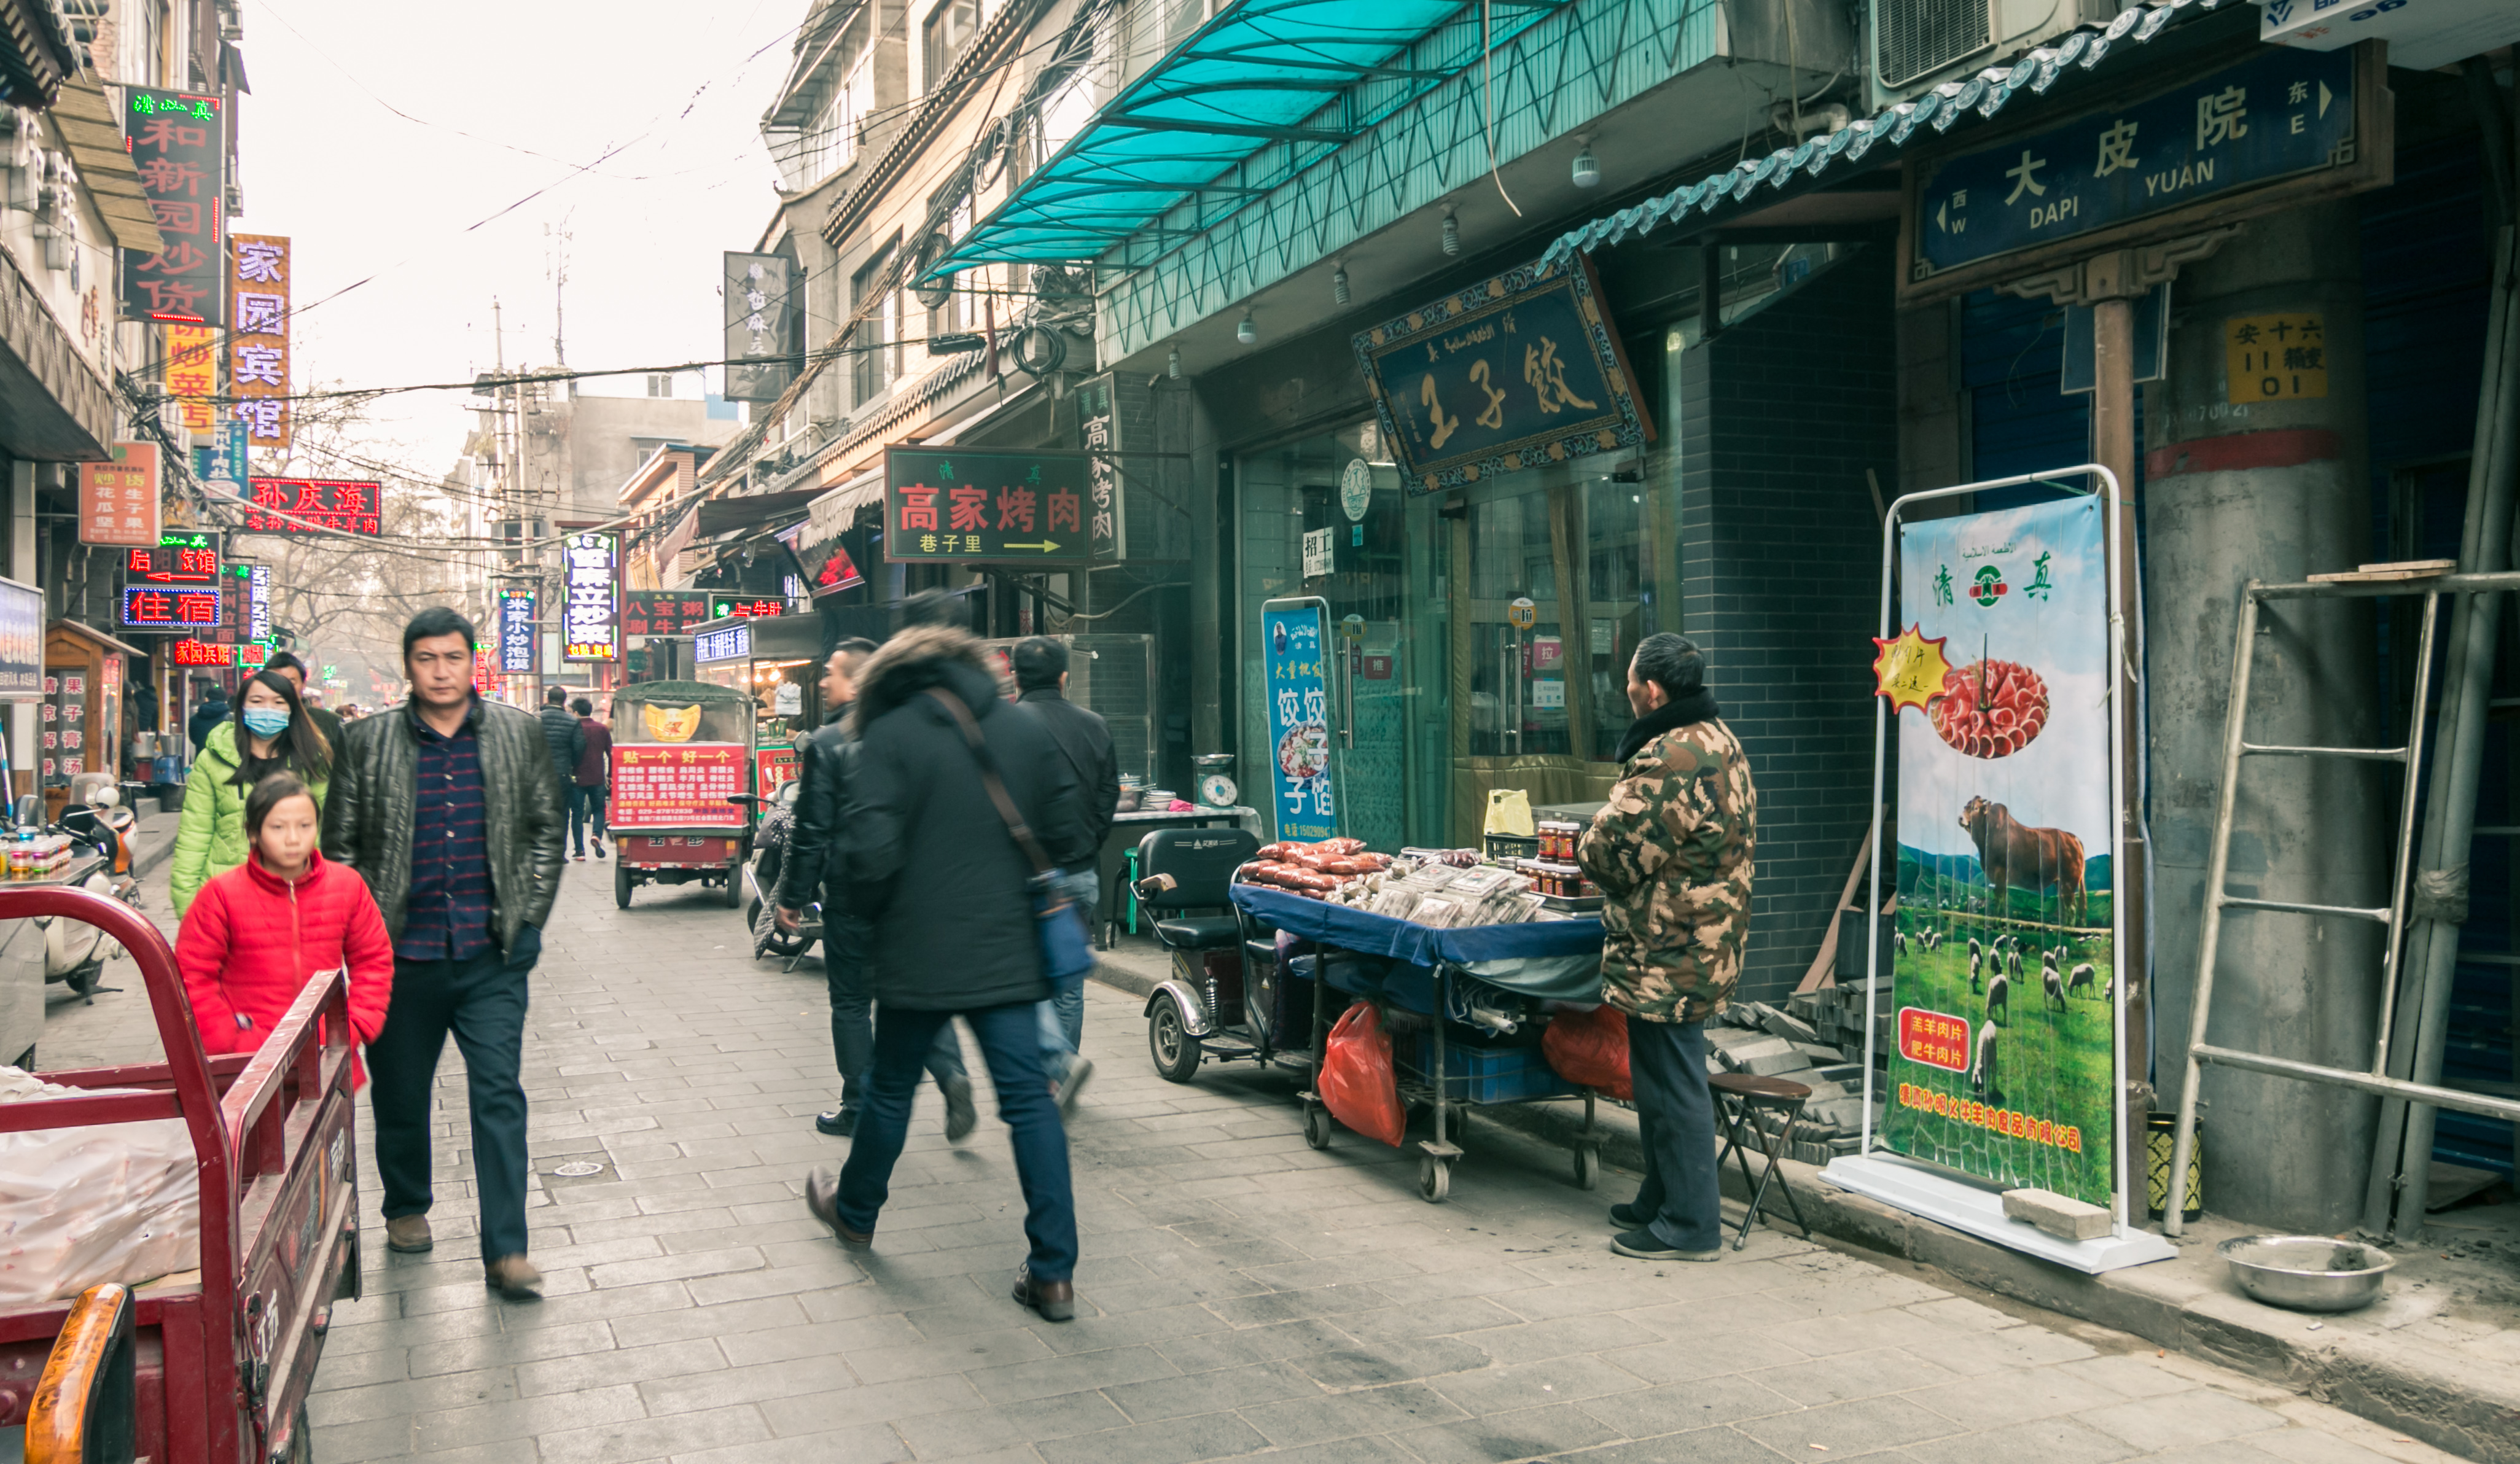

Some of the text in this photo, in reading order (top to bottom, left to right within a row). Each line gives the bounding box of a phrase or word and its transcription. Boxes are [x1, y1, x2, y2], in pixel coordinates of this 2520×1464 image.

[2288, 81, 2308, 104] 东
[2291, 114, 2304, 134] E
[2004, 85, 2248, 206] 大皮院
[2145, 158, 2214, 197] YUAN
[1952, 189, 1967, 209] 西
[137, 119, 209, 316] 和新园炒货
[1952, 217, 1966, 234] W
[2030, 196, 2078, 229] DAPI
[236, 241, 284, 438] 家园宾馆
[94, 473, 146, 487] 炒货
[938, 461, 1041, 485] 清 真
[1082, 415, 1113, 542] 高家烤肉
[252, 483, 368, 514] 孙庆海
[899, 483, 1080, 533] 高家烤肉
[920, 534, 982, 552] 巷子里
[1305, 532, 1332, 558] 招工
[1933, 564, 1954, 607] 清
[2023, 551, 2053, 602] 真
[130, 591, 216, 621] 住宿
[627, 601, 704, 617] 八宝粥
[506, 598, 529, 670] 米家小炒泡馍
[1373, 660, 1384, 671] 推
[1542, 646, 1553, 660] 拉
[63, 677, 84, 775] 果子膏汤
[623, 750, 730, 764] 贴一个 好一个
[1912, 1016, 1962, 1042] 羔羊肉片
[1911, 1040, 1962, 1066] 肥牛肉片
[1899, 1082, 2081, 1153] 清真孙明义牛羊肉食品有限公司
